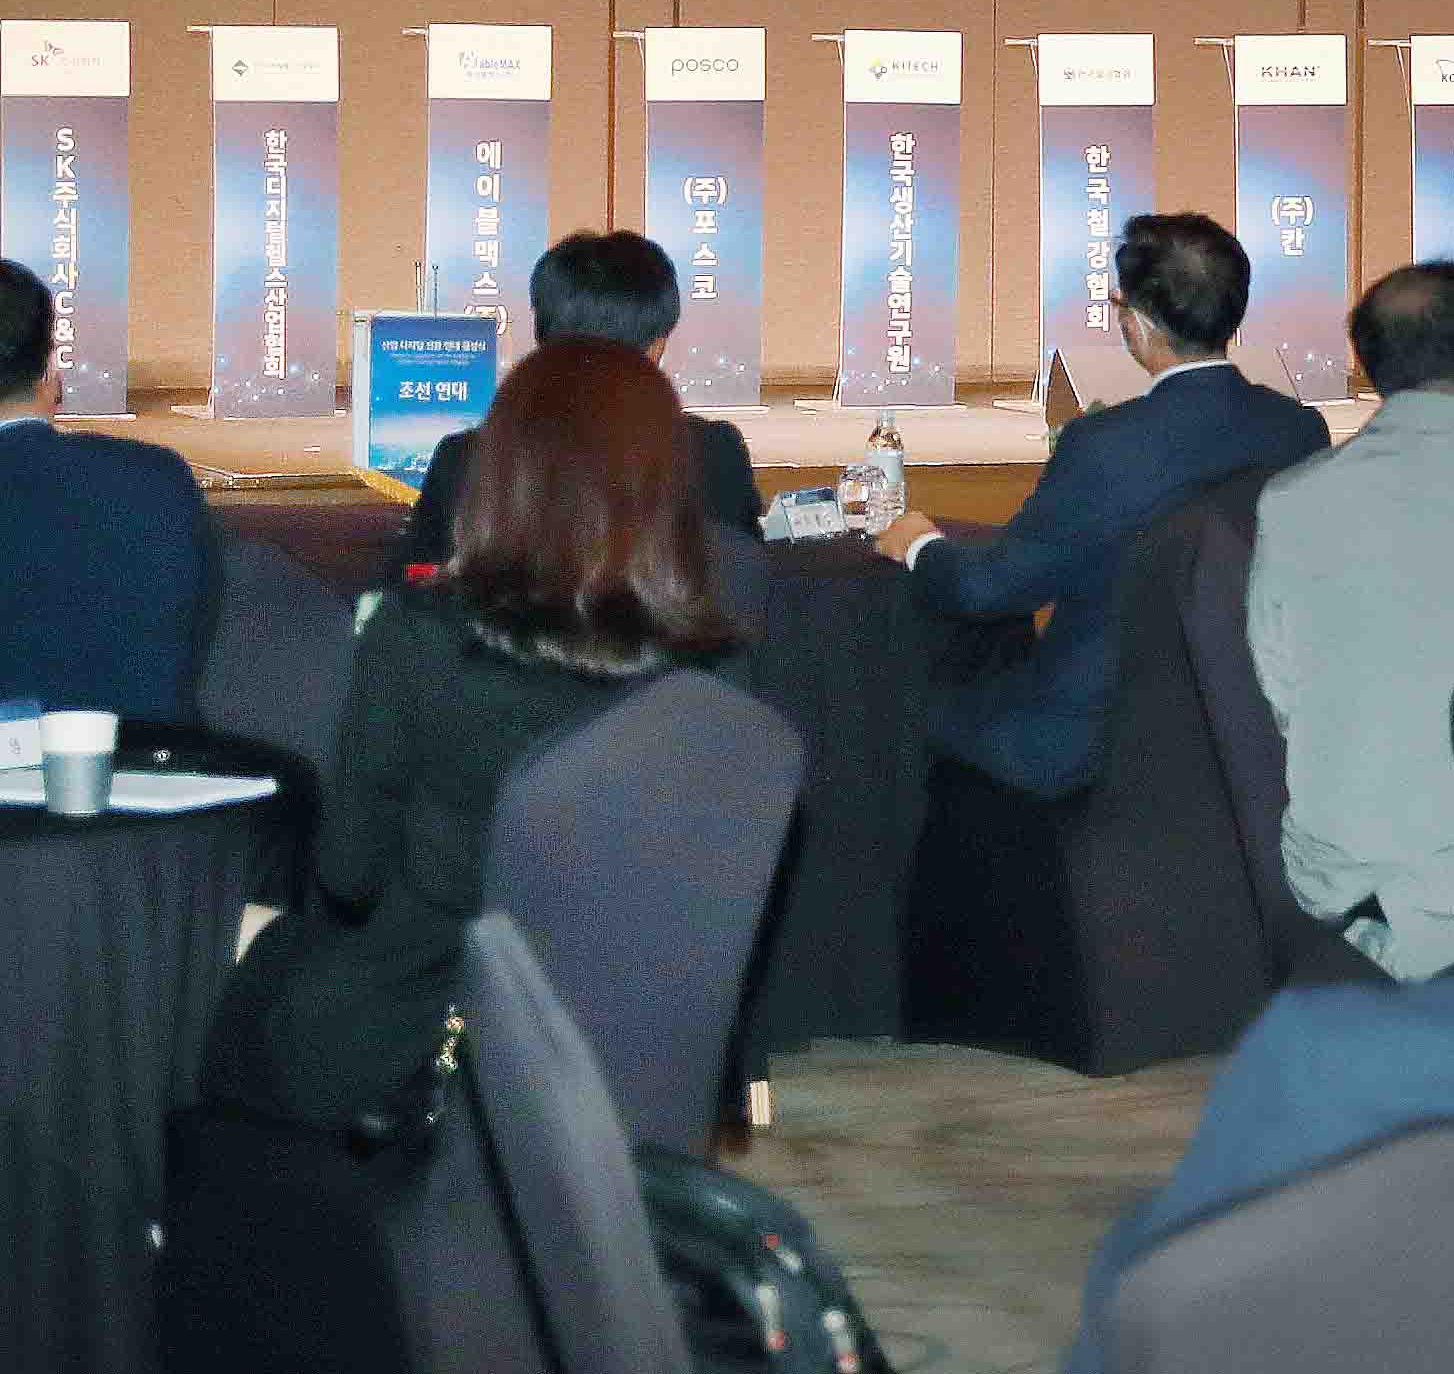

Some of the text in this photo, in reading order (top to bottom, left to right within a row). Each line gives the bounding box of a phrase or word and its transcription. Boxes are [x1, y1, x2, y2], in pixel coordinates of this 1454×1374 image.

[671, 58, 740, 77] posco
[1260, 65, 1317, 78] KHAN
[52, 127, 80, 370] SK주식회사C&C
[682, 176, 728, 300] (주)포스코
[886, 132, 916, 374] 한국생산기술연구원
[1085, 144, 1111, 332] 한국철강협회
[399, 381, 468, 402] 조선 연대
